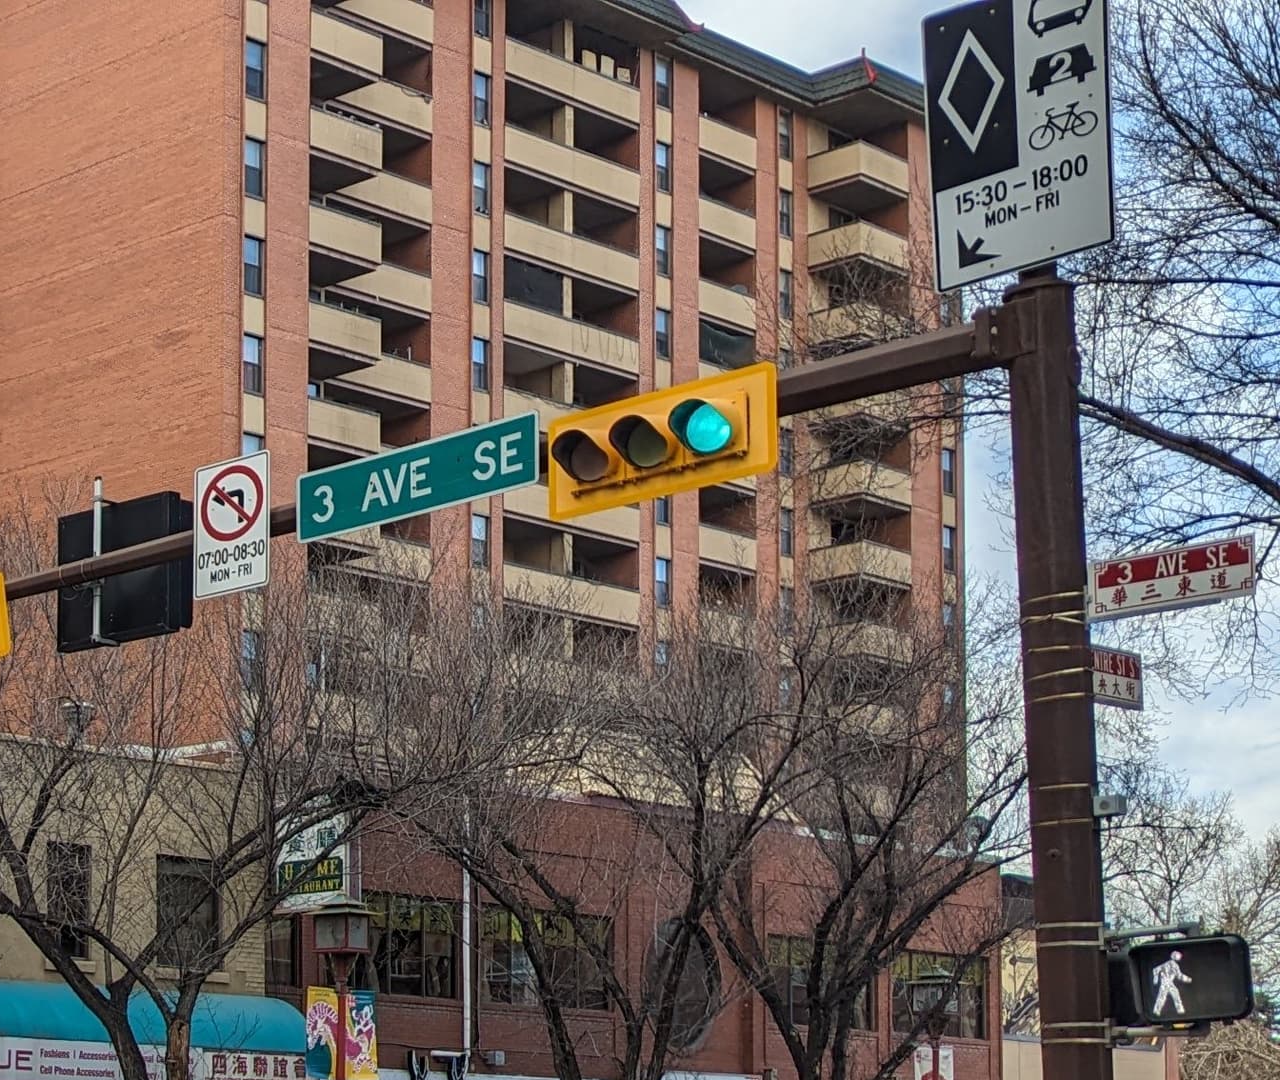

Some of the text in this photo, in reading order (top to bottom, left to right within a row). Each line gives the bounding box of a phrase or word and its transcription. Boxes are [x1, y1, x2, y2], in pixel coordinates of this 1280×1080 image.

[1049, 51, 1073, 83] 2
[955, 180, 1007, 215] 15:30
[1032, 154, 1088, 191] 18:00
[312, 431, 523, 523] 3 AVE SE
[1117, 544, 1229, 584] 3 AVE SE
[1094, 651, 1113, 674] NTRE
[1129, 658, 1136, 678] S
[1098, 675, 1136, 699] 央大街
